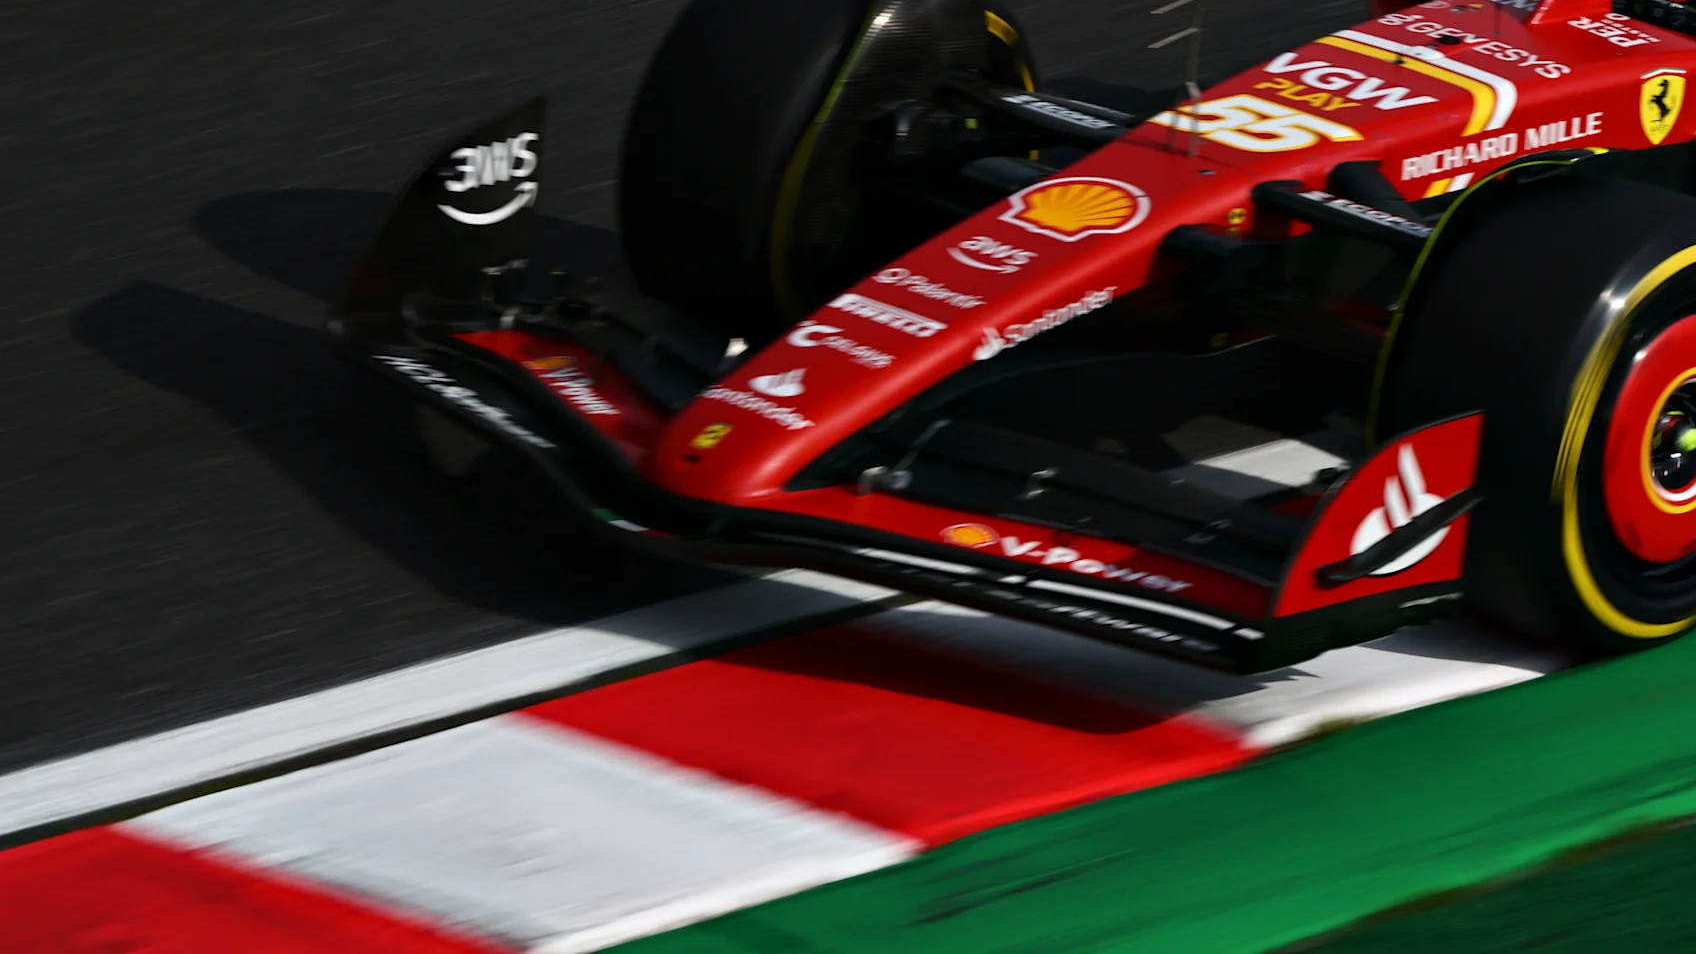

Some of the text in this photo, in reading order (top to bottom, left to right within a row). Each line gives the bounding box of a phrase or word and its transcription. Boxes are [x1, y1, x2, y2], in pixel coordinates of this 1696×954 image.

[1405, 22, 1571, 79] GENESYS
[1253, 77, 1363, 112] PLAY
[1262, 52, 1440, 111] VGW
[1147, 93, 1364, 153] 55
[1401, 112, 1603, 181] RICHARD MILLE
[826, 292, 949, 338] PIRELLI
[1000, 536, 1194, 593] V-Power
